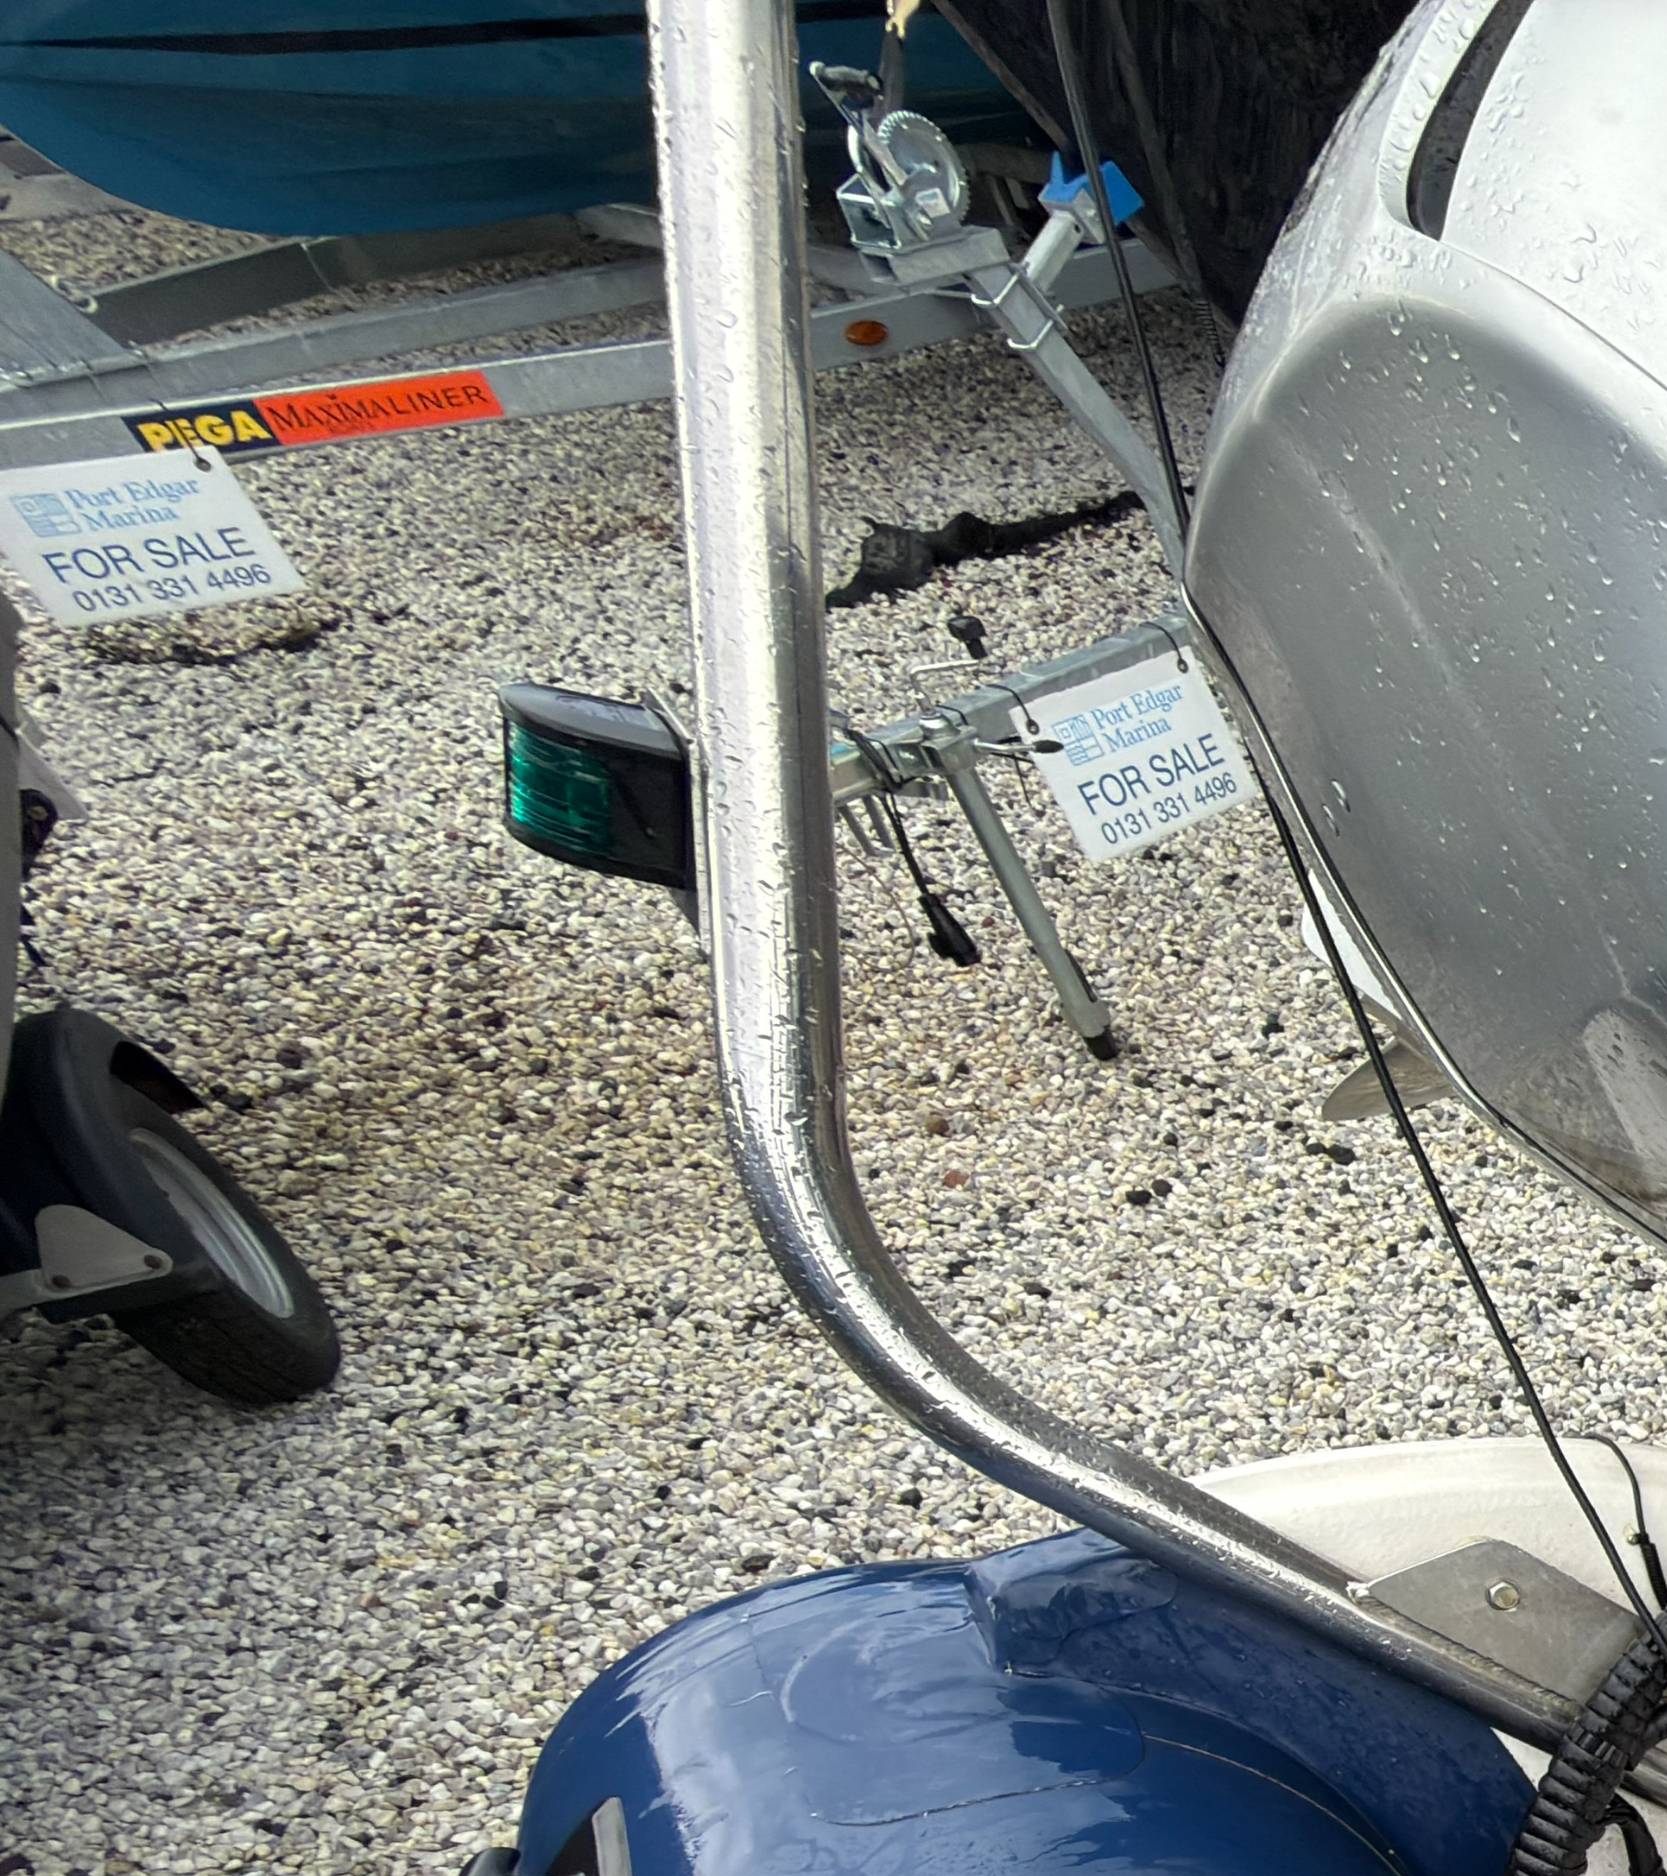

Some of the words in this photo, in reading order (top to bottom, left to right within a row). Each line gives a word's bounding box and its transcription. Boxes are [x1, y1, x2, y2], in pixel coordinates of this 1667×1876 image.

[136, 410, 273, 452] PEGA
[66, 487, 122, 515] Port
[129, 477, 201, 506] Edgar
[82, 504, 179, 532] Marina
[42, 544, 141, 585] FOR
[143, 526, 257, 568] SALE
[73, 582, 143, 613] 0131
[153, 574, 199, 602] 331
[206, 562, 273, 592] 4496
[1091, 705, 1135, 730] Port
[1131, 682, 1185, 713] Edgar
[1101, 716, 1173, 755] Marina
[1077, 764, 1151, 816] FOR
[1149, 733, 1226, 788] SALE
[1101, 807, 1153, 846] 0131
[1152, 792, 1191, 823] 331
[1194, 771, 1238, 807] 4496
